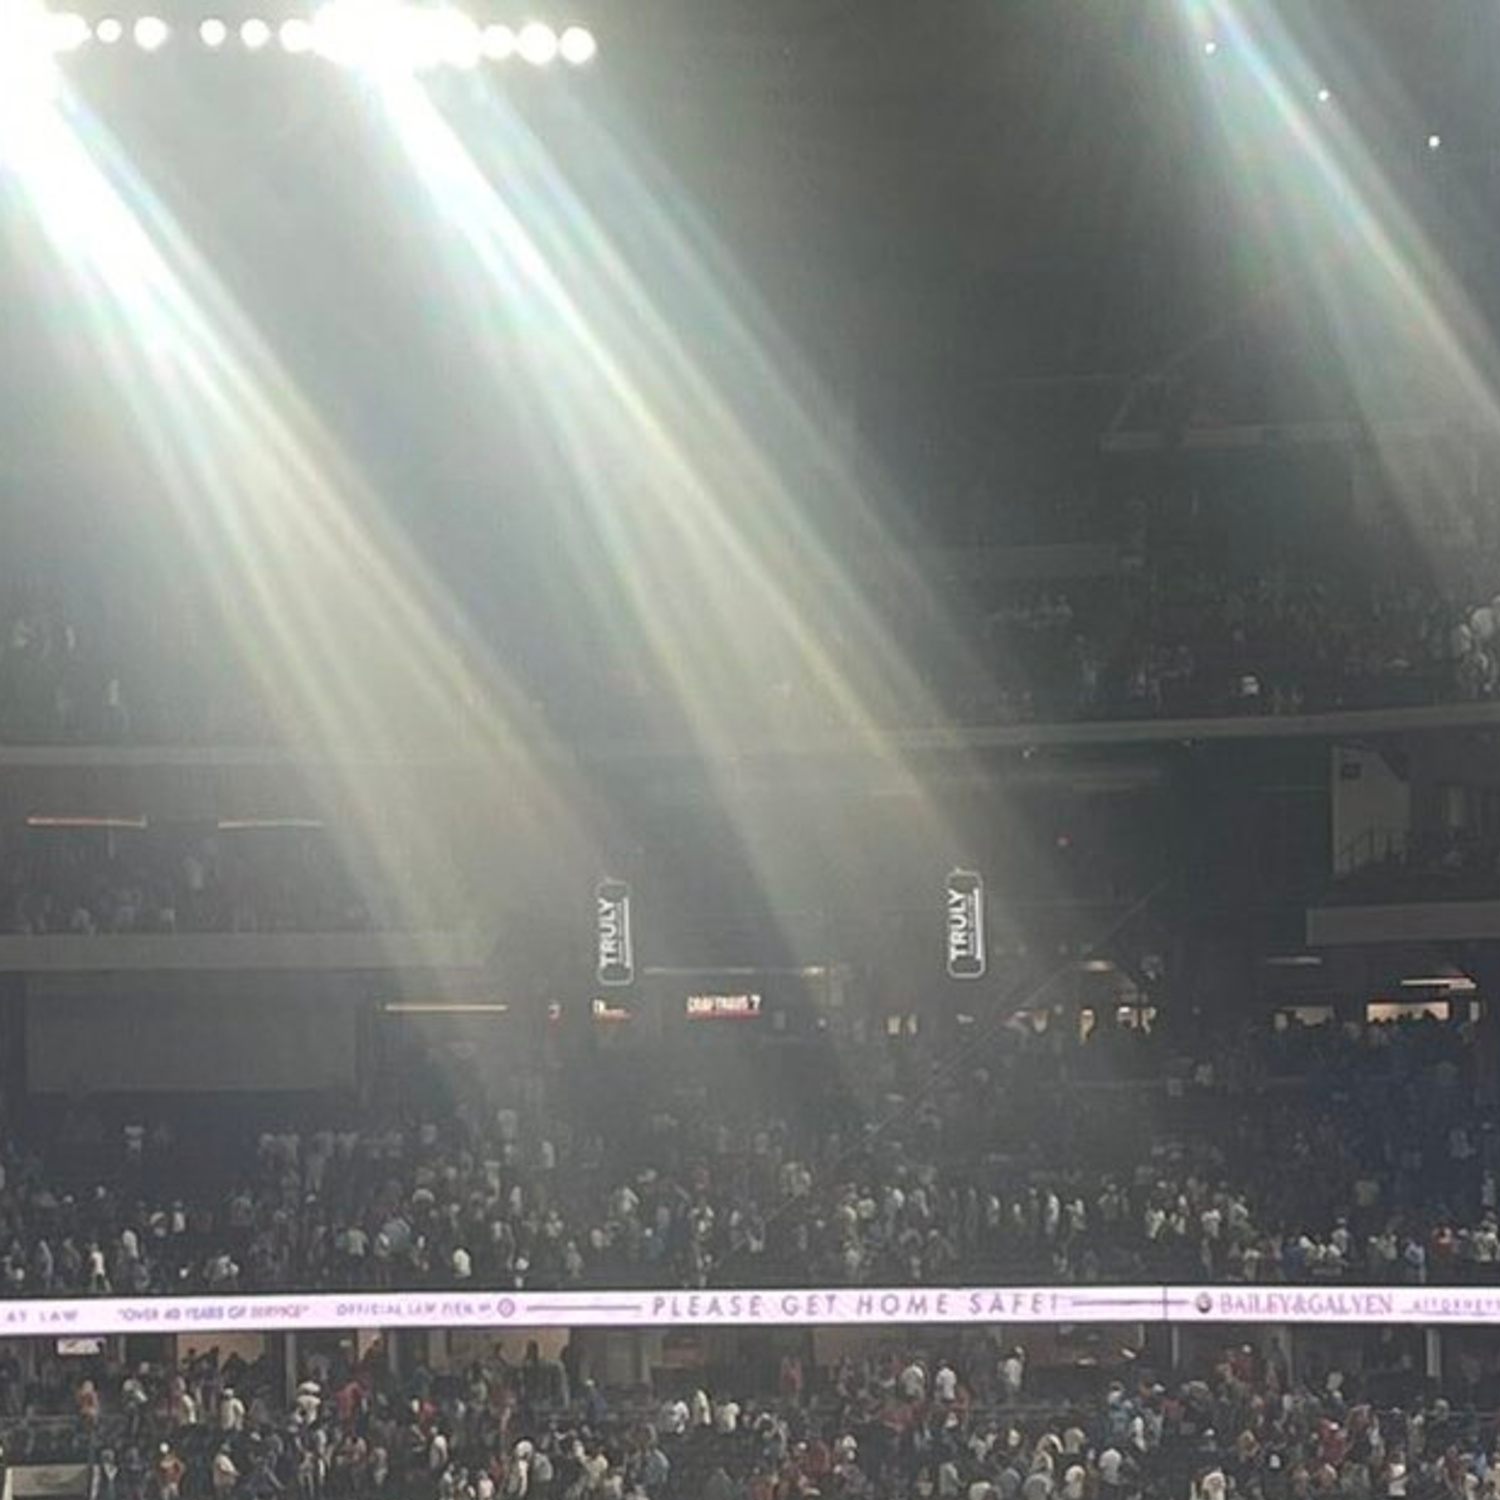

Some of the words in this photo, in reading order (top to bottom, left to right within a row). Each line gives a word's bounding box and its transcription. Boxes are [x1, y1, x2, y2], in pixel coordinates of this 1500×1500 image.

[598, 897, 618, 969] TRULY
[948, 887, 967, 961] TRULY
[39, 1310, 79, 1321] LAW
[184, 1305, 224, 1319] YEARS
[336, 1302, 401, 1316] OFFICIAL
[406, 1301, 437, 1315] LAW
[652, 1296, 763, 1317] PLEASE
[780, 1295, 838, 1316] GET
[857, 1294, 950, 1315] HOME
[969, 1292, 1058, 1313] SAFE!
[1220, 1293, 1394, 1316] BAILEY&GALYEN
